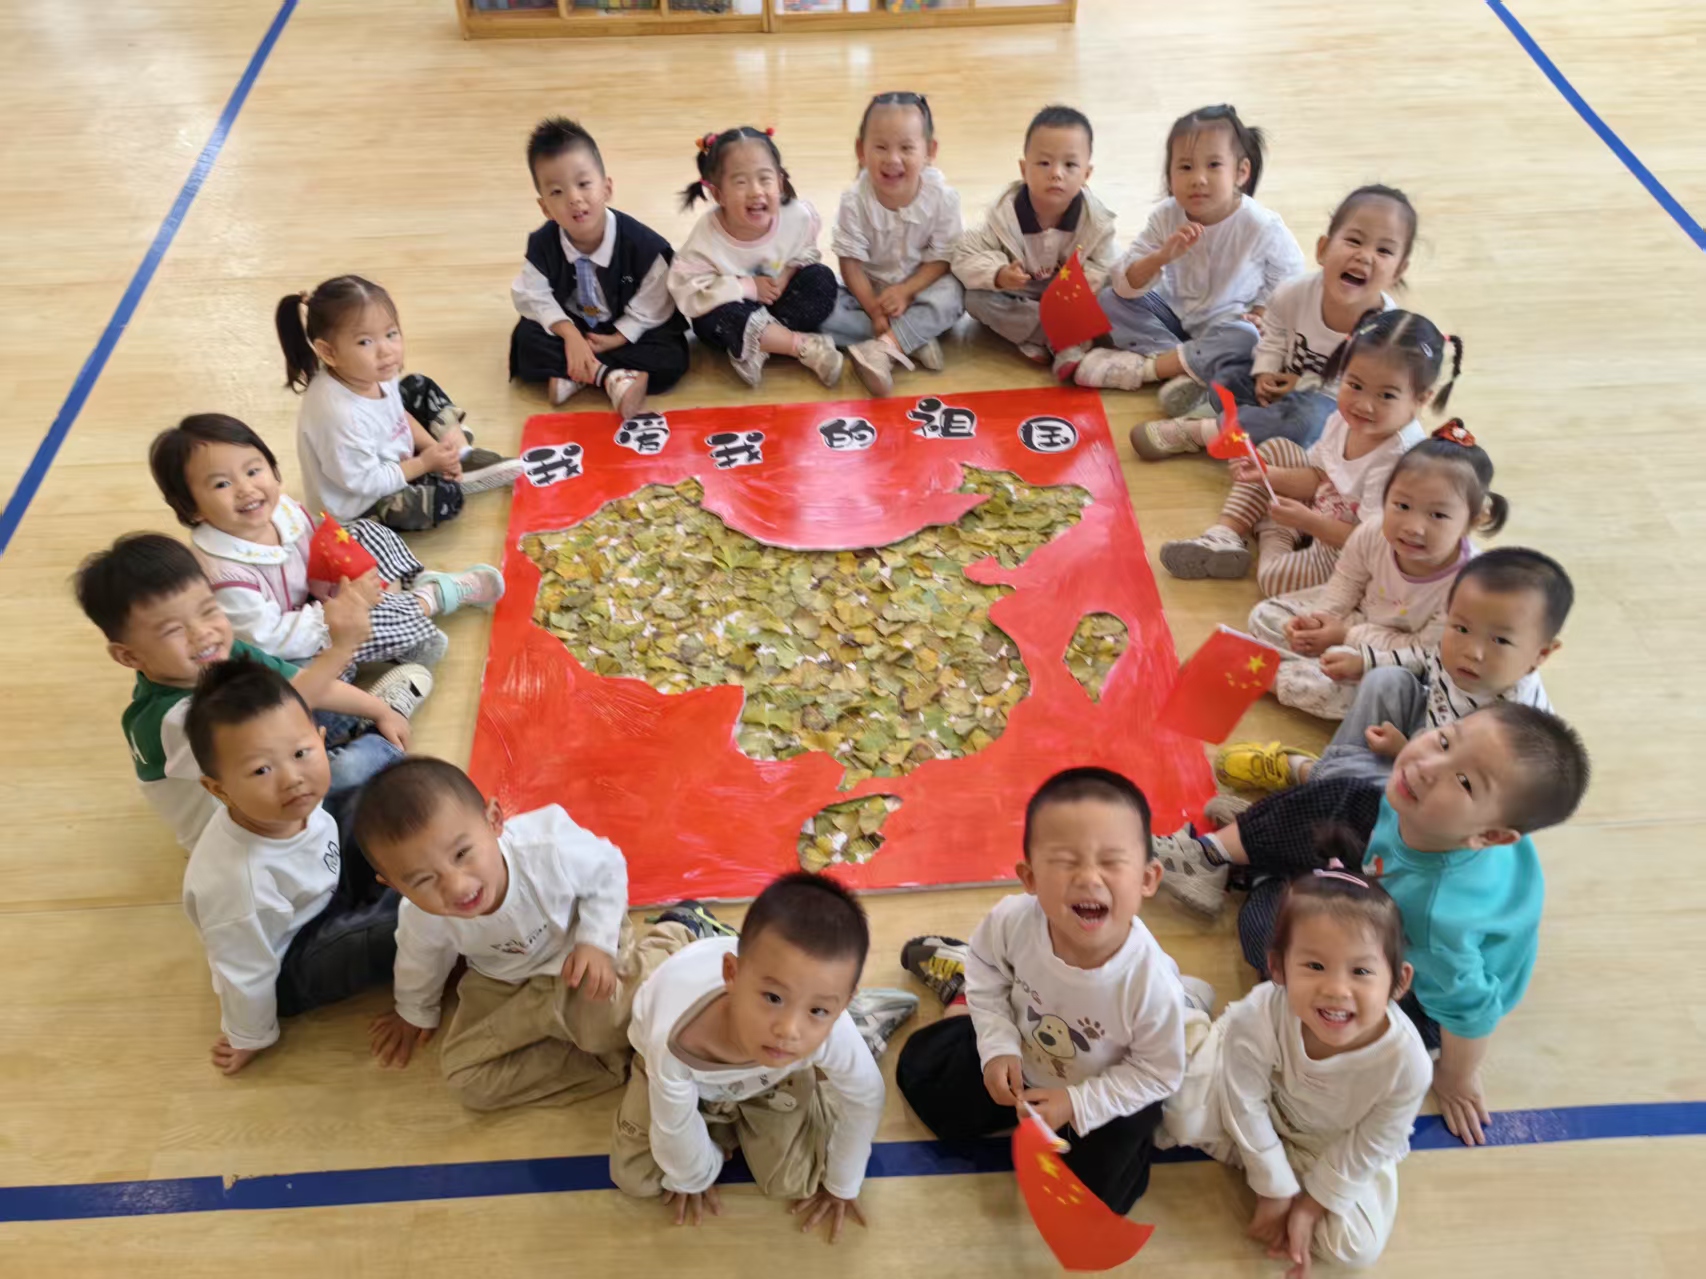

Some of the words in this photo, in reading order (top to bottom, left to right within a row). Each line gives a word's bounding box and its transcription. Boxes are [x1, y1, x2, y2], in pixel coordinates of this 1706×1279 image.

[522, 398, 1077, 486] 我爱我的祖国
